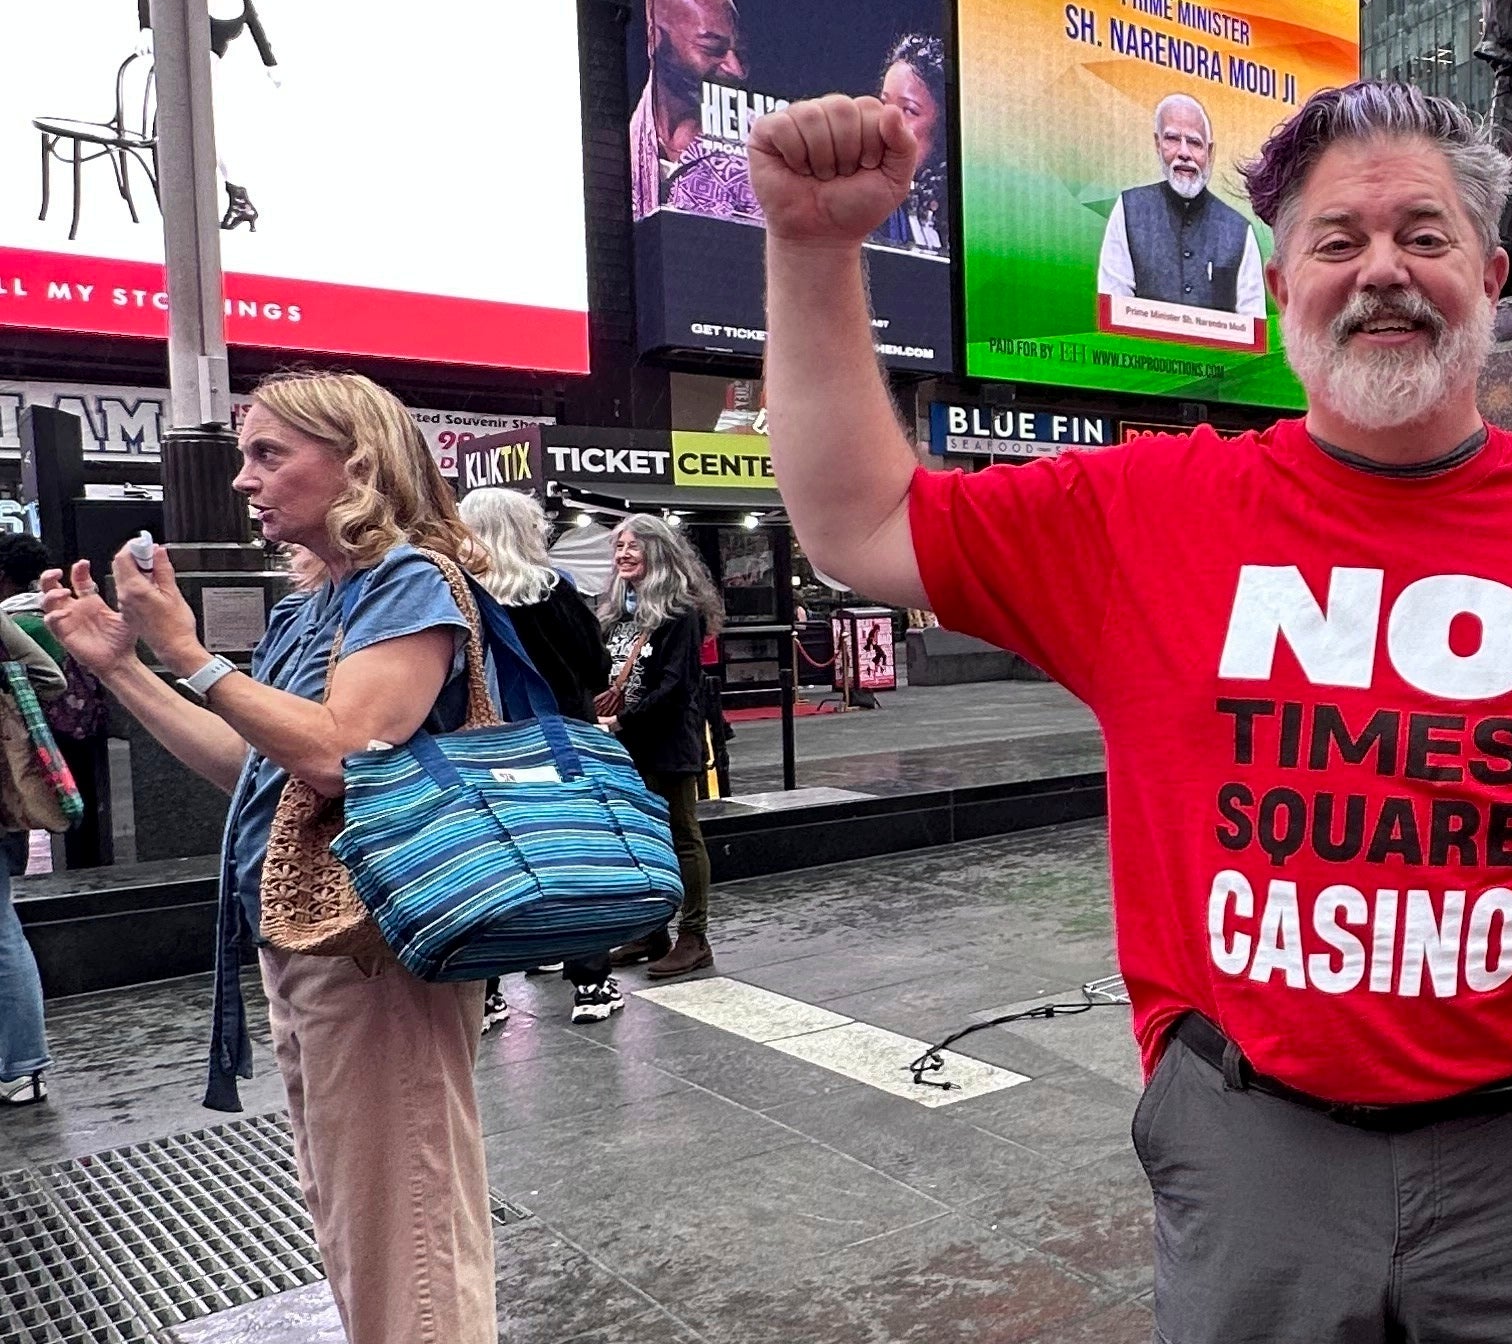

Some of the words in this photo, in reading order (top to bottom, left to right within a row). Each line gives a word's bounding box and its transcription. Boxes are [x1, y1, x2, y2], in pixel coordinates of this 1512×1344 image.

[1065, 3, 1103, 47] SH.
[1110, 17, 1223, 85] NARENDRA
[1229, 53, 1277, 102] MODI
[1282, 72, 1296, 105] JI
[47, 281, 95, 303] MY
[690, 322, 721, 337] GET
[1125, 305, 1149, 318] Prime
[1150, 309, 1181, 322] Minister
[1195, 316, 1228, 330] Narendra
[1228, 321, 1247, 332] Modi
[988, 336, 1014, 356] PAID
[1016, 339, 1038, 358] FOR
[1039, 342, 1054, 360] BY
[411, 412, 440, 424] ted
[445, 414, 508, 429] Souvenir
[949, 406, 1037, 440] BLUE
[1053, 416, 1104, 445] FIN
[949, 437, 1034, 455] SEAFOOD
[465, 441, 532, 489] KLIKTIX
[547, 446, 670, 475] TICKET
[677, 452, 775, 478] CENTE
